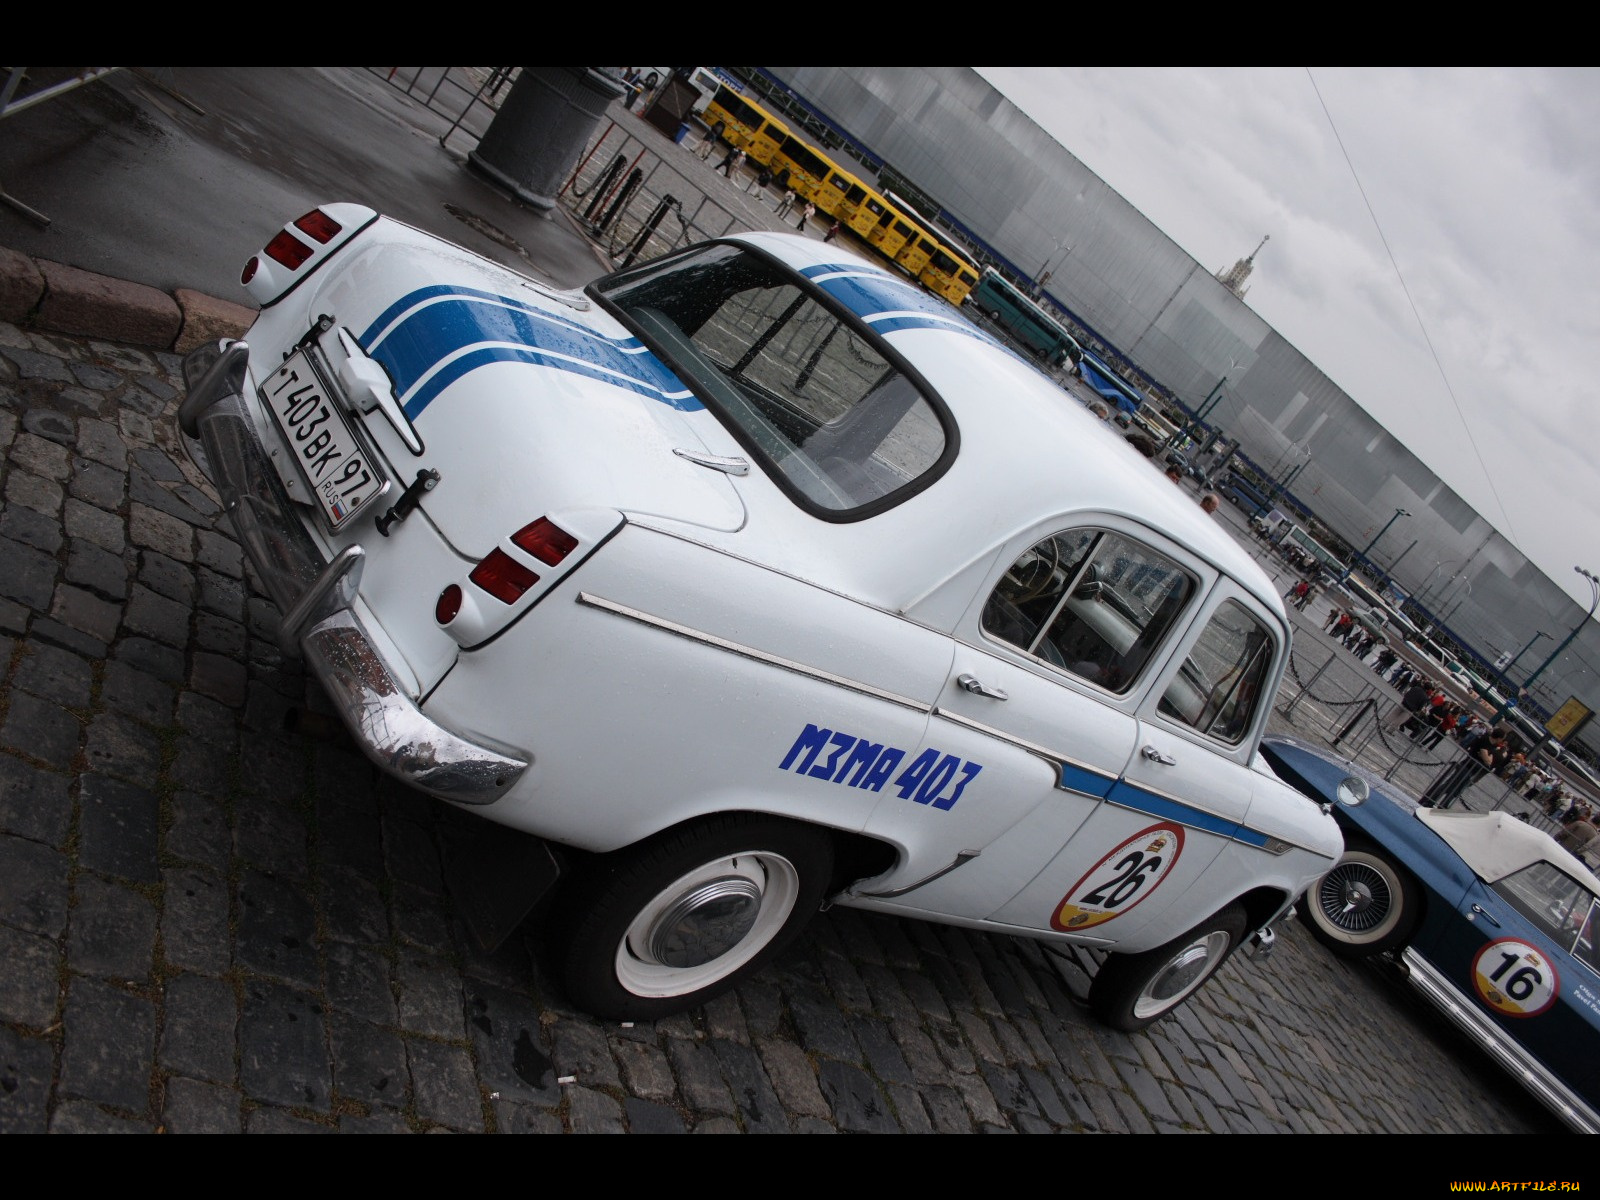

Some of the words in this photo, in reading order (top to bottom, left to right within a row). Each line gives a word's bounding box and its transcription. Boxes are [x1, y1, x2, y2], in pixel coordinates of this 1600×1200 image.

[321, 481, 340, 505] RUS
[335, 459, 371, 497] 97
[893, 747, 983, 812] 403
[1079, 850, 1163, 909] 26
[1489, 951, 1543, 1001] 16
[1573, 989, 1591, 1006] Pavel
